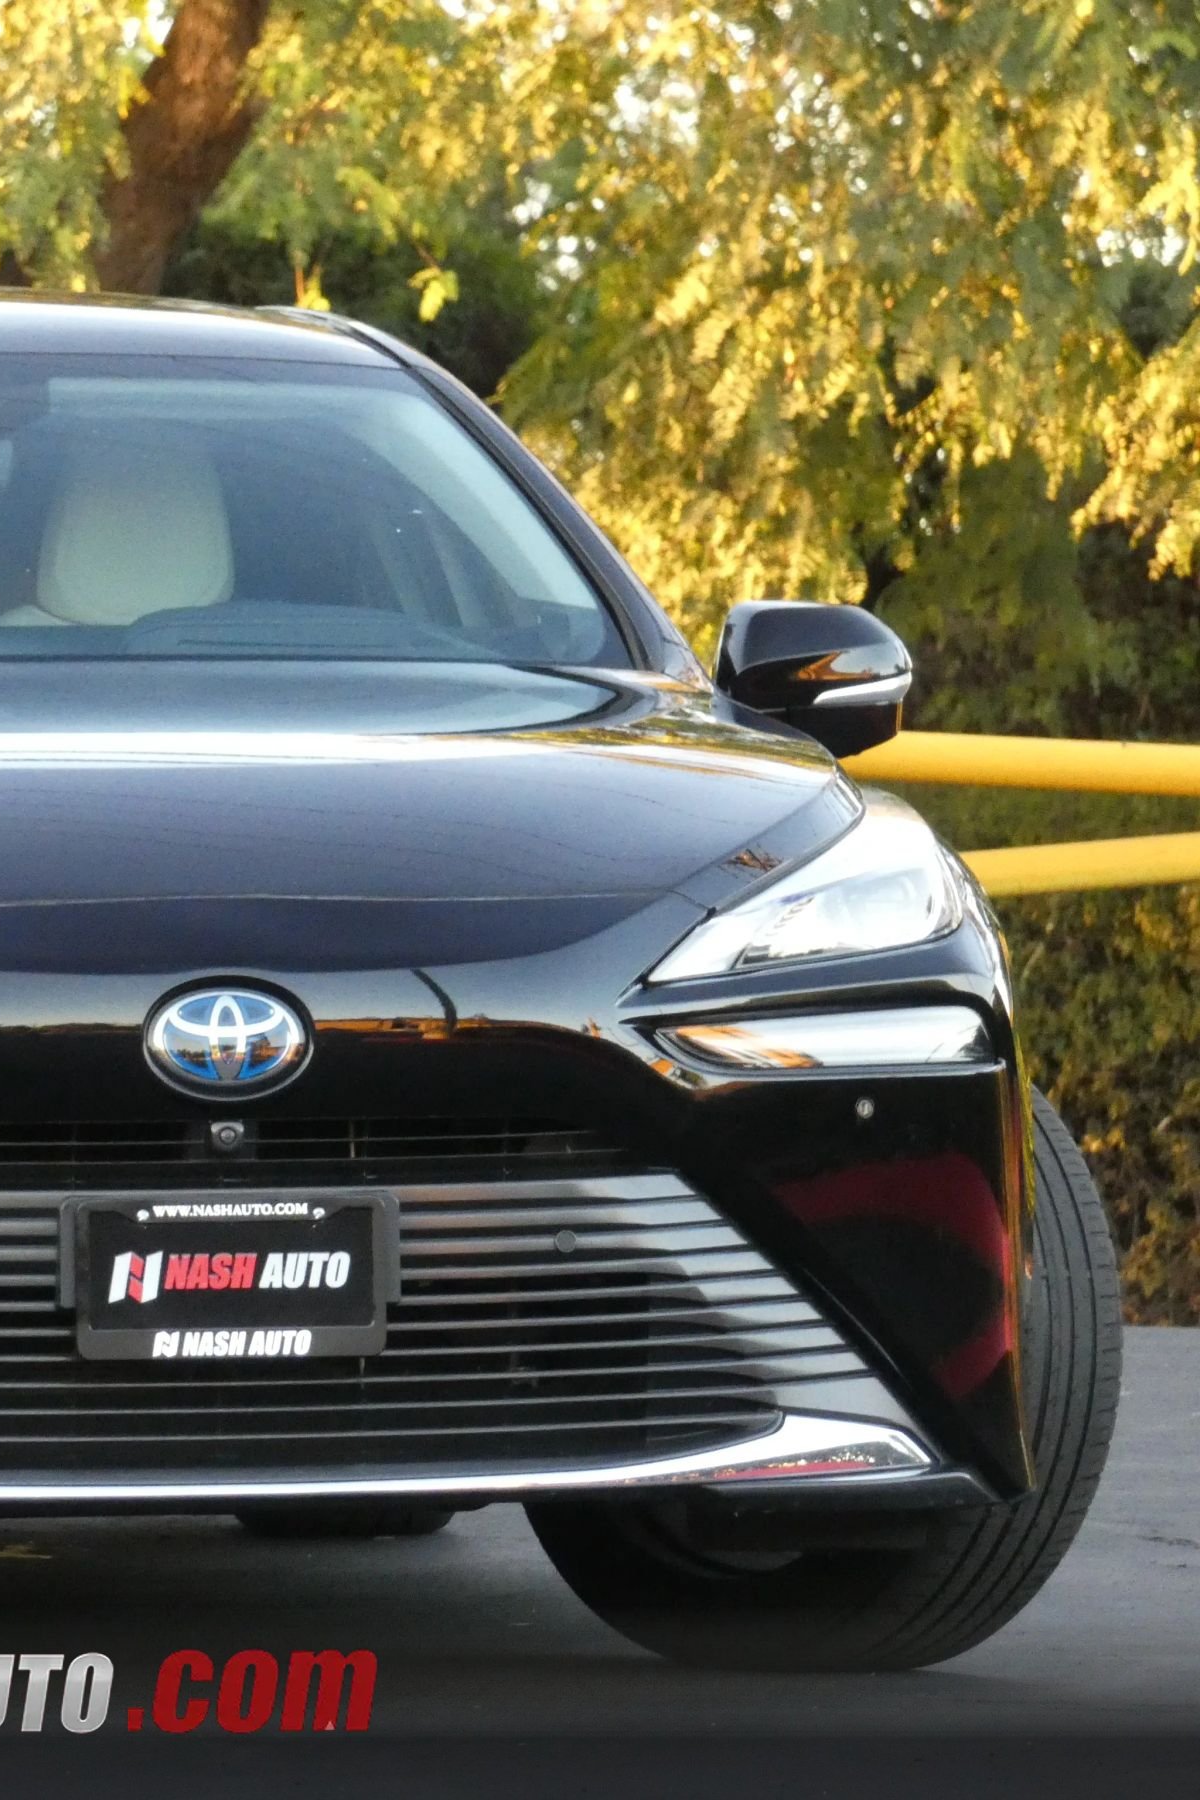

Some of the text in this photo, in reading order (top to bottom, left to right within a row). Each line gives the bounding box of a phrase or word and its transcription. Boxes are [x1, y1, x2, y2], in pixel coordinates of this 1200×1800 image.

[153, 1202, 309, 1218] WWW.NASHAUTO.COM
[164, 1253, 258, 1291] NASH
[259, 1251, 351, 1289] AUTO
[182, 1331, 247, 1357] NASH
[248, 1329, 312, 1356] AUTO
